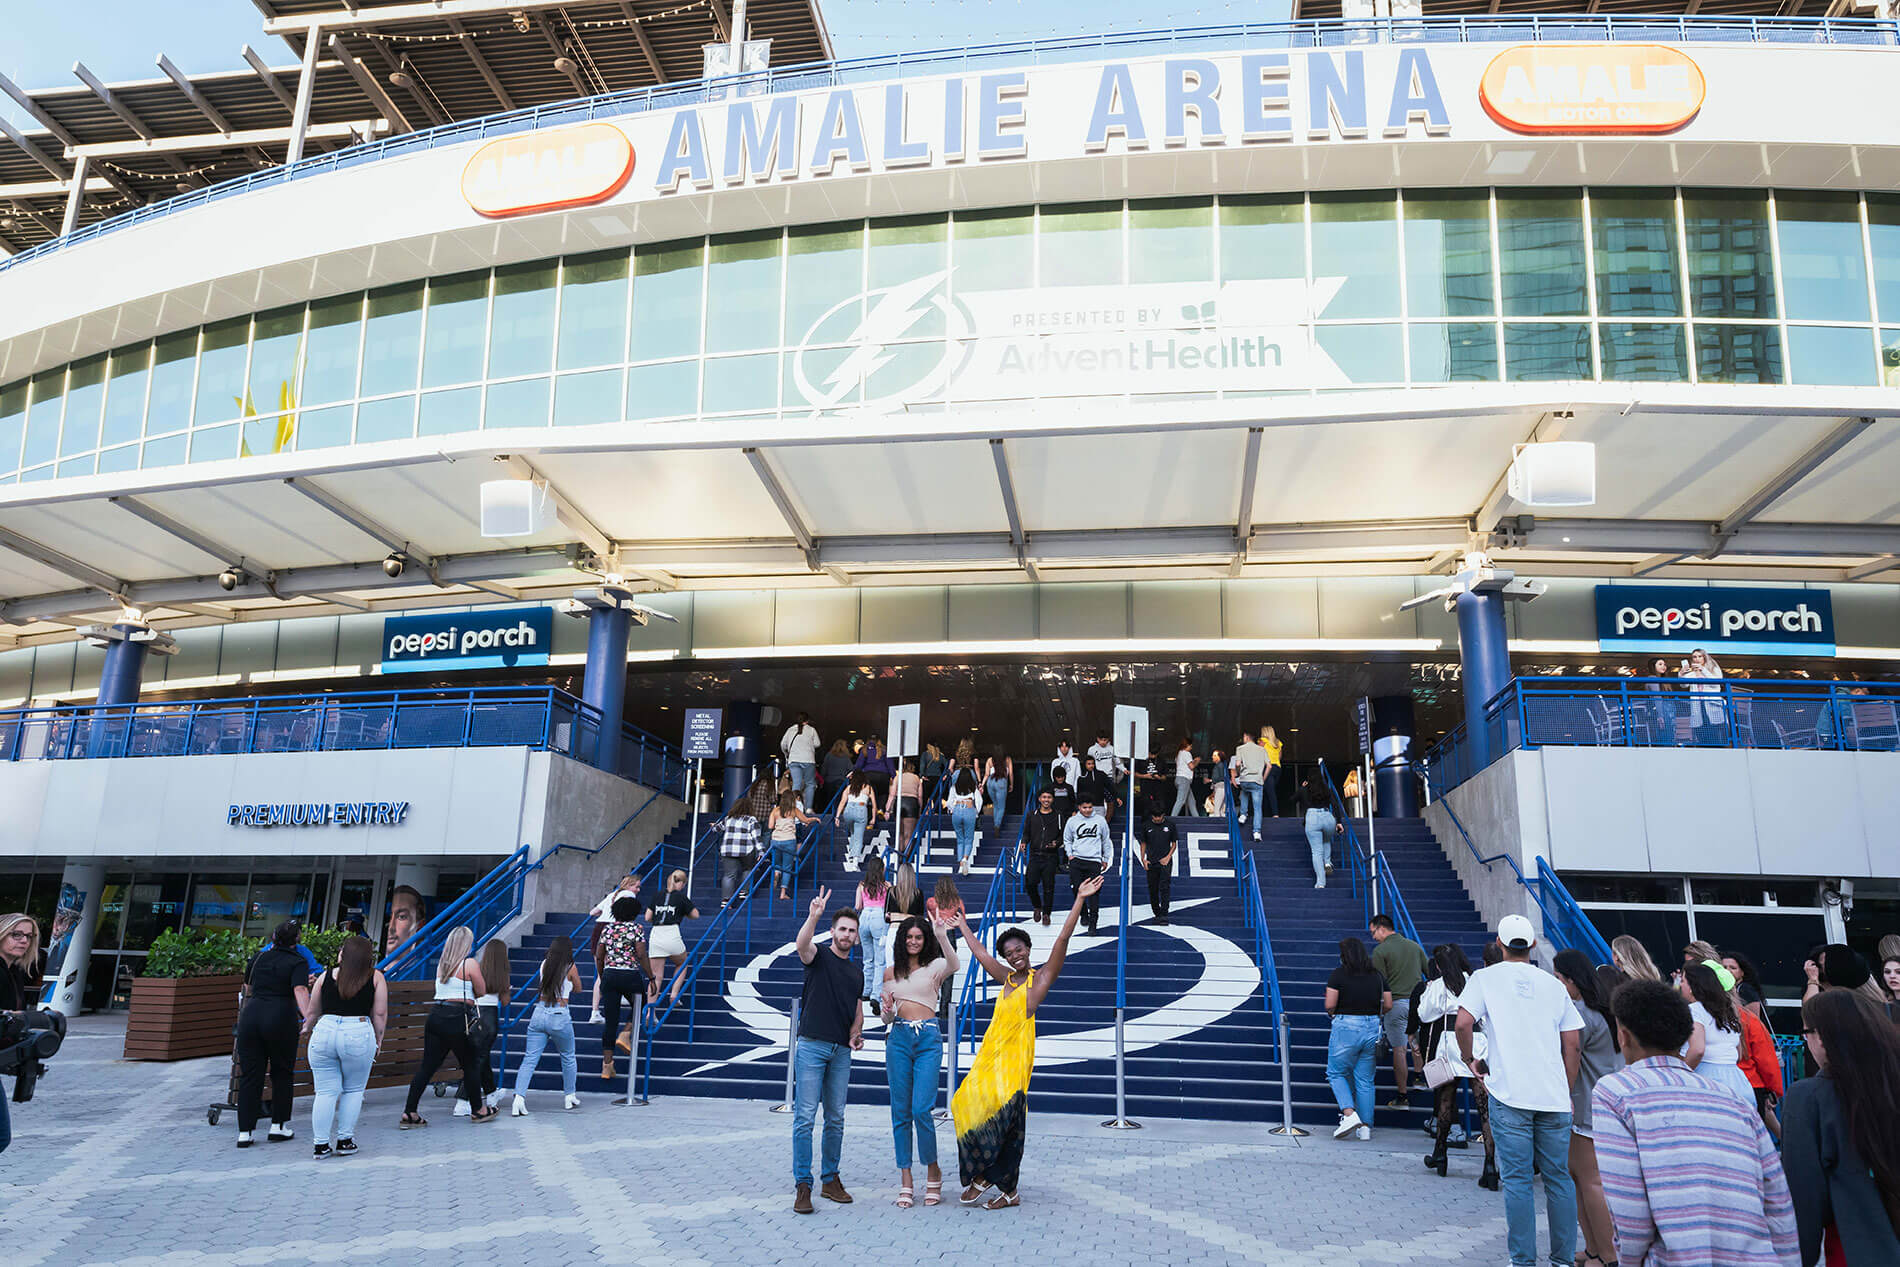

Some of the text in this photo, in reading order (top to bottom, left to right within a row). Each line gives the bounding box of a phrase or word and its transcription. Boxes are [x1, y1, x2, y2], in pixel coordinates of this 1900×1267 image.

[1500, 64, 1694, 104] AMALIE
[655, 48, 1451, 194] AMALIE ARENA
[1548, 106, 1641, 121] MOTOR OIL
[1012, 308, 1162, 329] PRESENTED BY
[996, 336, 1282, 374] AdventHealth
[1616, 603, 1822, 637] pepsi porch
[389, 621, 536, 658] pepsi porch
[227, 801, 407, 826] PREMIUM ENTRY
